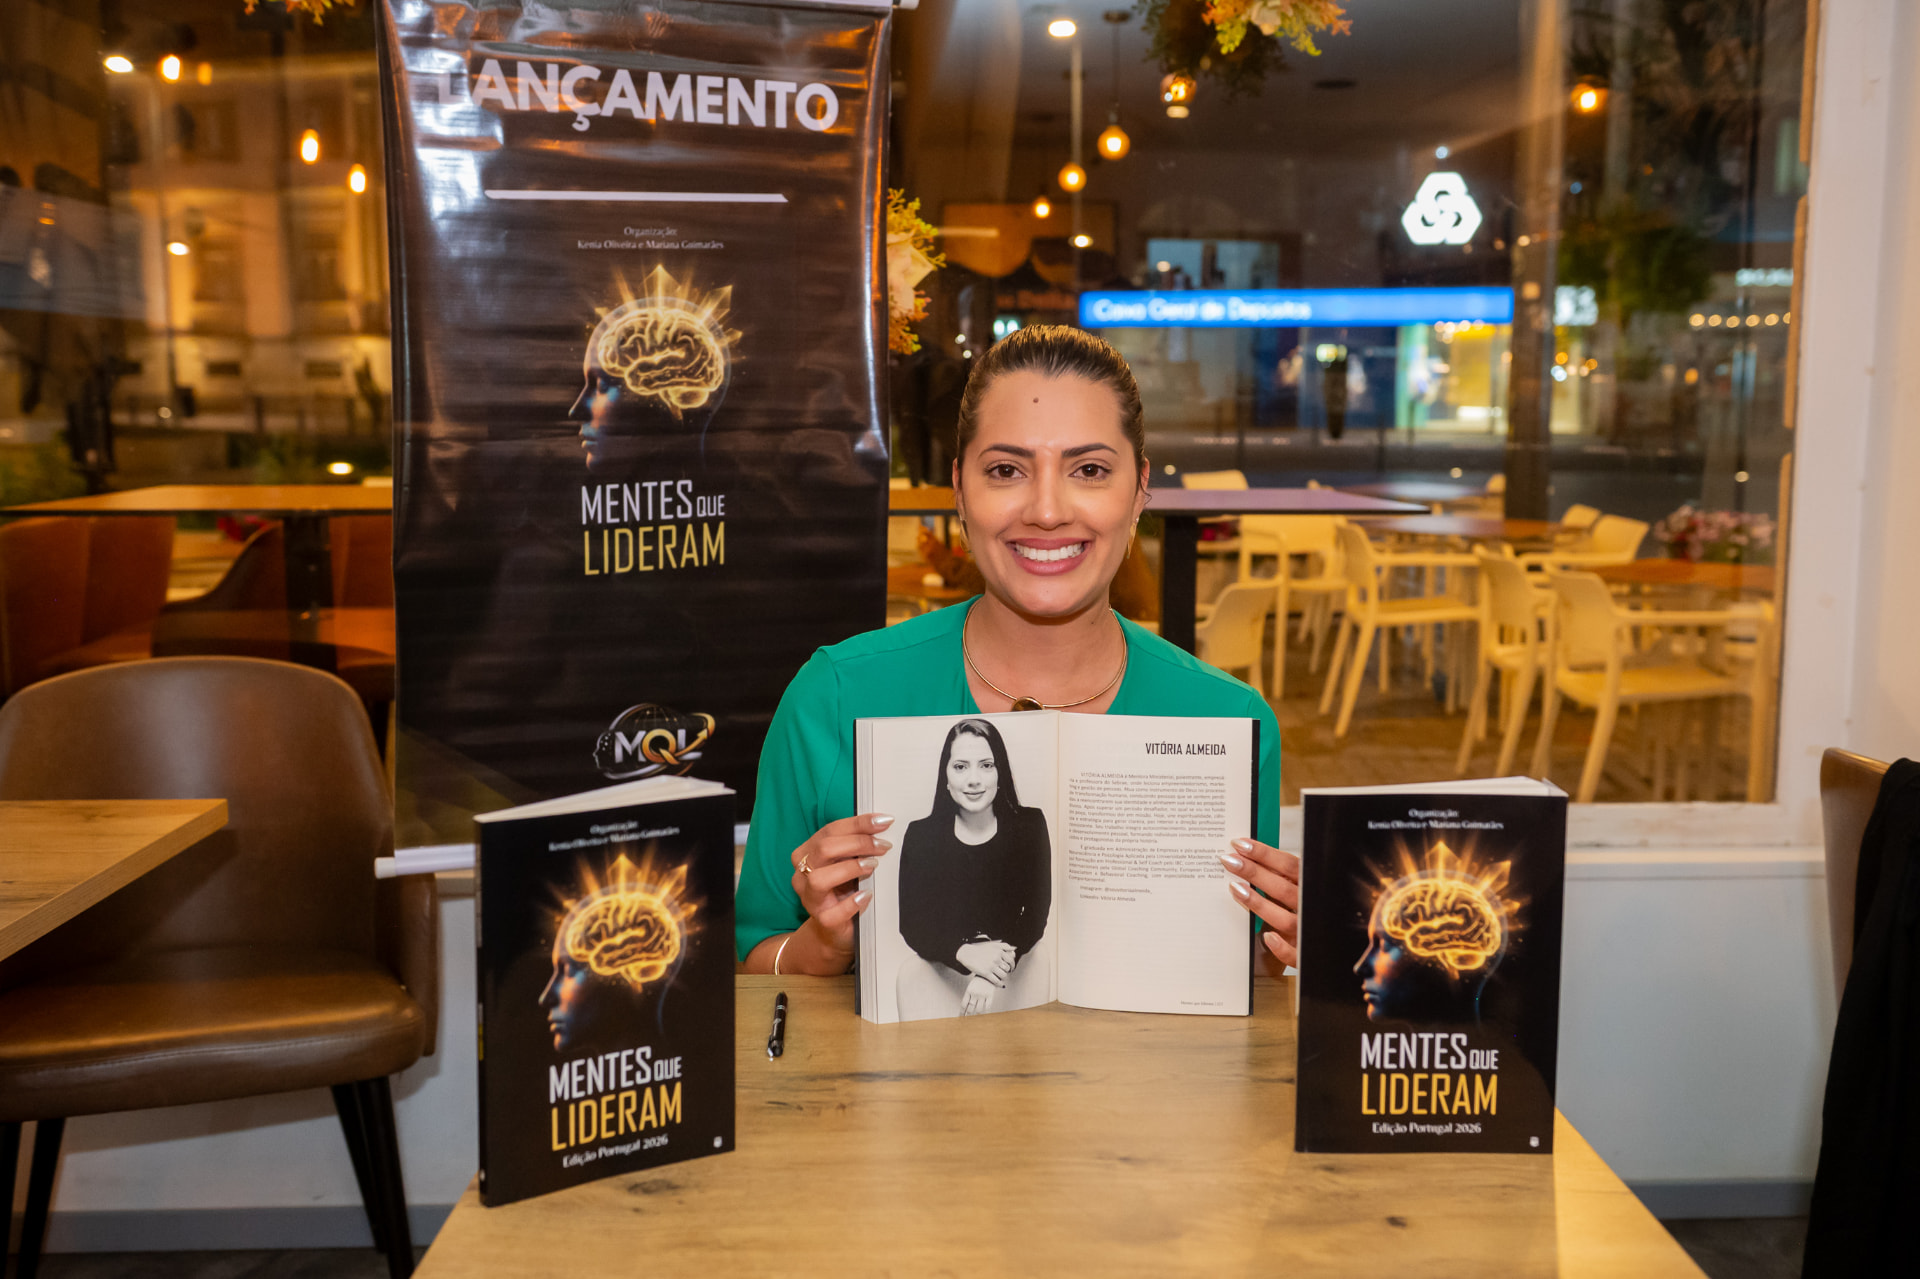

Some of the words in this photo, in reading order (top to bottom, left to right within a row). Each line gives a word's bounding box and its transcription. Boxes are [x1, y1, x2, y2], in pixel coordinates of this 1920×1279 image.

[438, 58, 840, 132] LANÇAMENTO
[603, 239, 637, 249] Oliveira
[638, 241, 643, 249] e
[645, 239, 680, 249] Mariana
[581, 479, 693, 525] MENTES
[696, 494, 726, 518] QUE
[584, 521, 725, 576] LIDERAM
[614, 728, 703, 765] MQL
[1145, 741, 1183, 755] VITÓRIA
[1185, 743, 1227, 756] ALMEIDA
[1360, 1032, 1468, 1070] MENTES
[1469, 1049, 1499, 1070] QUE
[549, 1045, 652, 1104] MENTES
[653, 1056, 682, 1082] QUE
[1361, 1073, 1498, 1116] LIDERAM
[551, 1081, 682, 1152] LIDERAM
[1372, 1121, 1407, 1135] Edição
[1409, 1121, 1453, 1136] Portugal
[1455, 1122, 1482, 1134] 2026
[562, 1149, 597, 1168] Edição
[598, 1139, 641, 1159] Portugal
[642, 1133, 669, 1150] 2026
